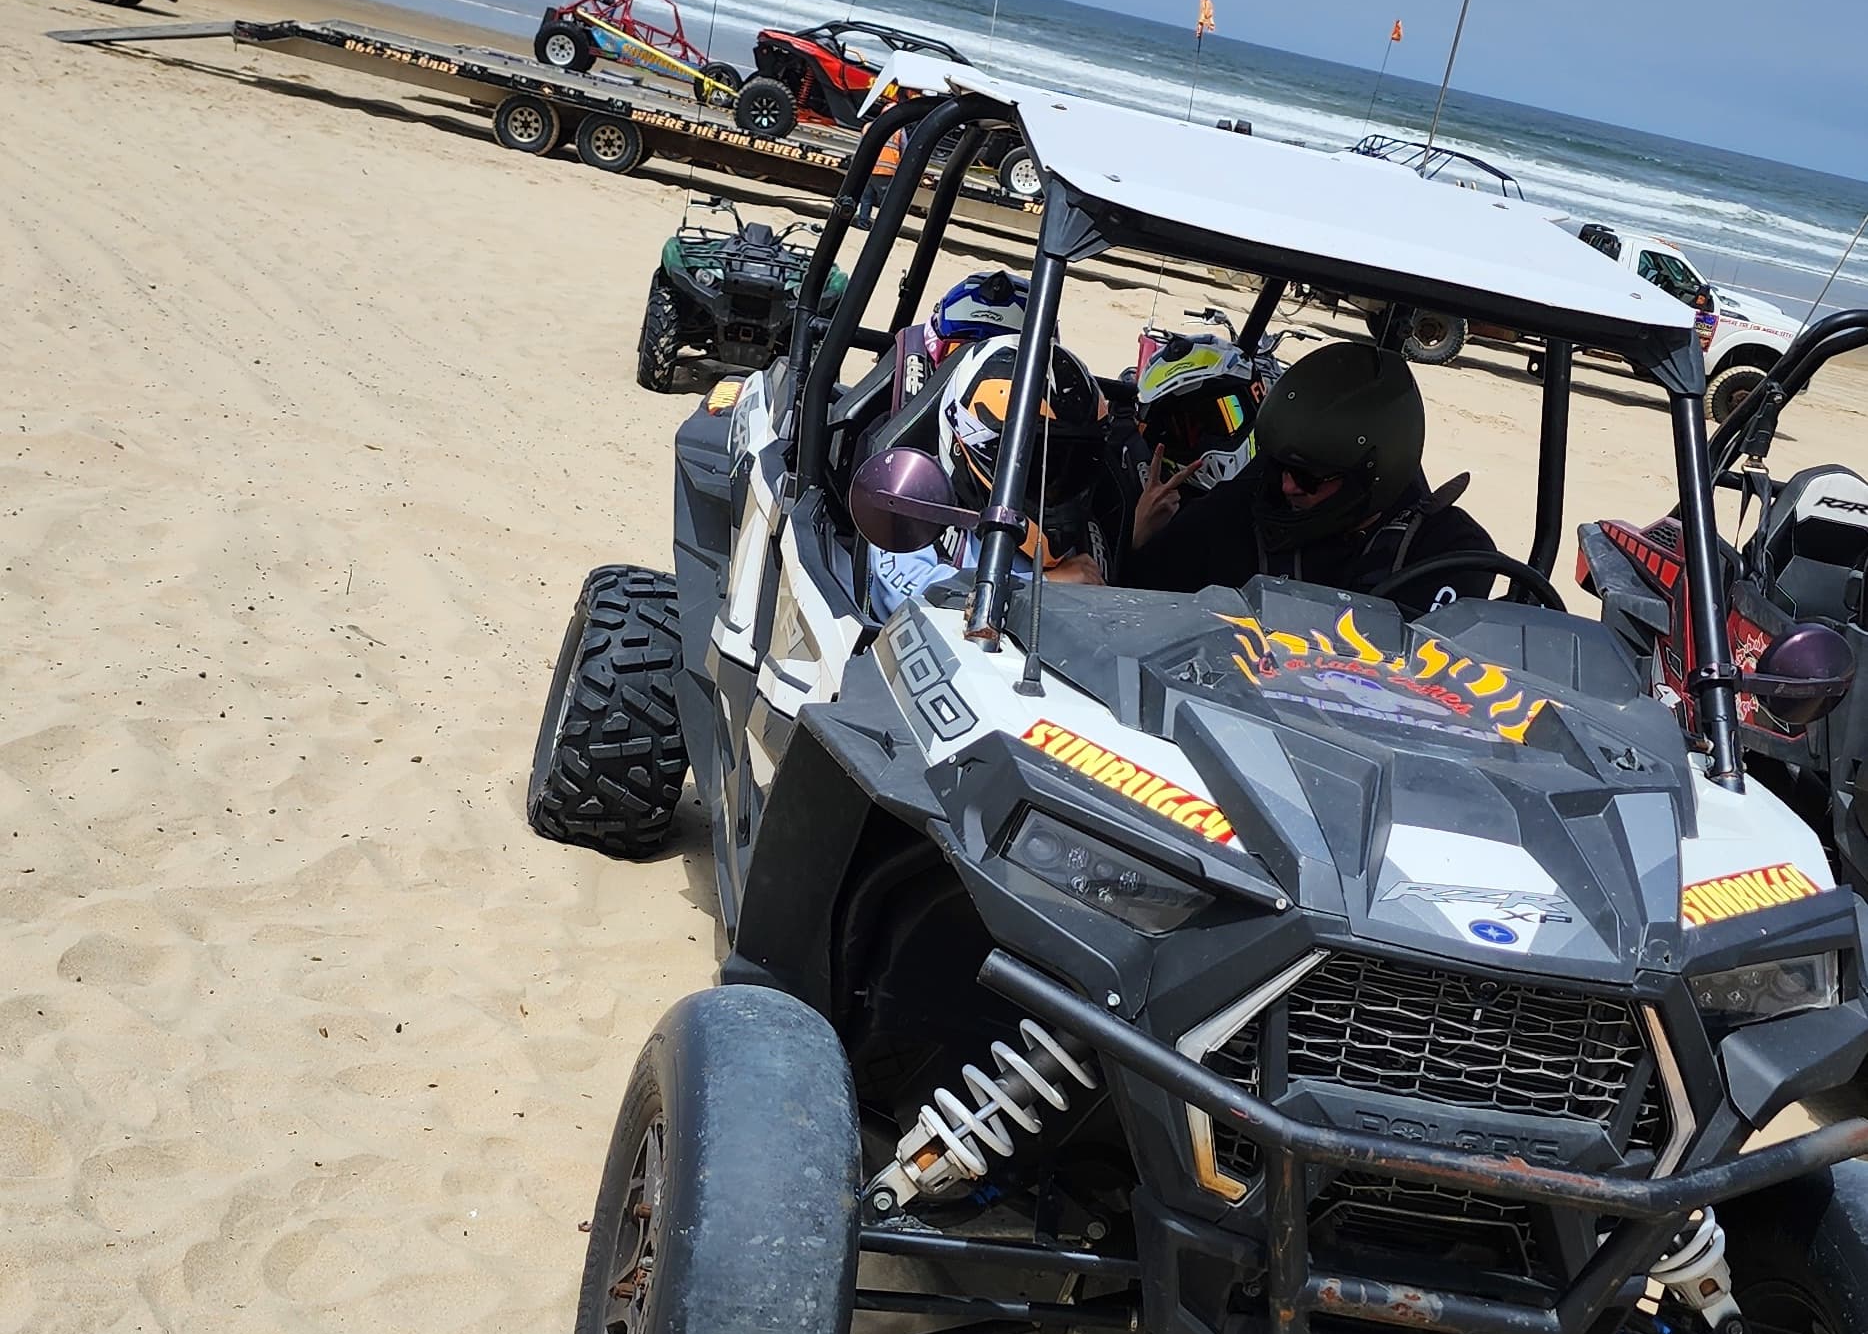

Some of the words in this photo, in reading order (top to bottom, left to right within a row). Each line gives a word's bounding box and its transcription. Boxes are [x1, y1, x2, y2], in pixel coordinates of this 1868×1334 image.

[631, 109, 683, 130] WHERE
[688, 123, 717, 139] THE
[719, 132, 750, 146] FUN
[754, 139, 801, 159] NEVER
[806, 152, 841, 167] SETS
[885, 608, 980, 743] 1000
[1020, 722, 1233, 843] SUNBUGGY
[1378, 880, 1568, 914] RZR
[1502, 909, 1573, 924] XP
[1682, 863, 1817, 925] SUNBUGGY
[1354, 1110, 1570, 1165] POLARIS
